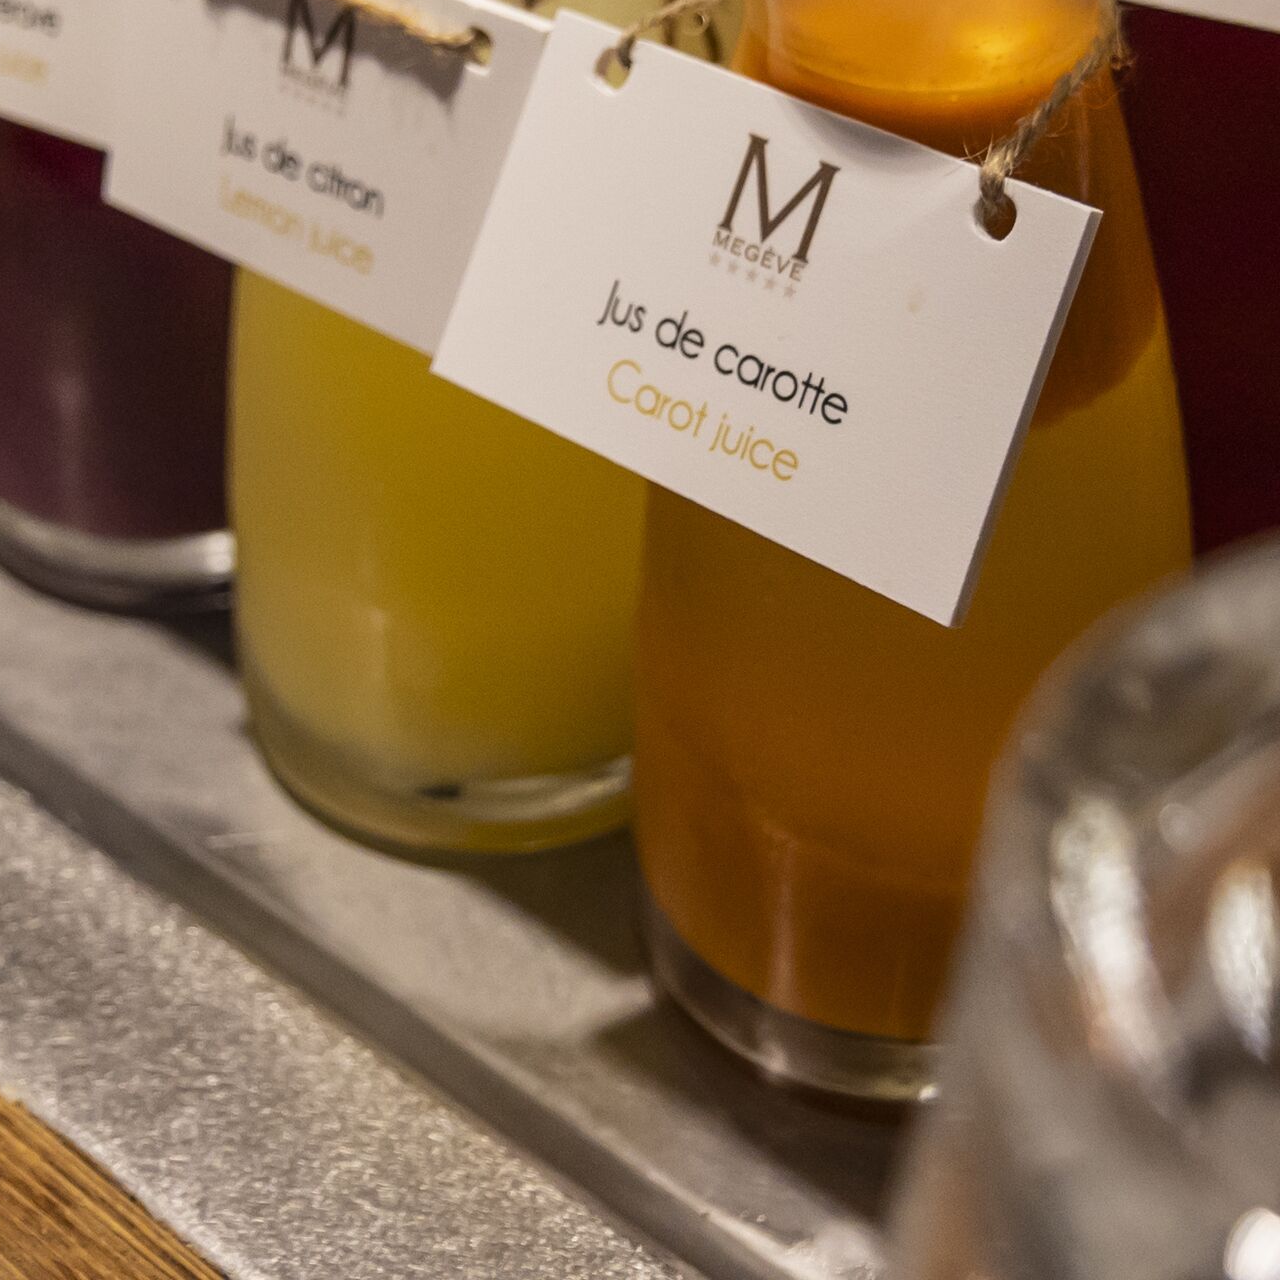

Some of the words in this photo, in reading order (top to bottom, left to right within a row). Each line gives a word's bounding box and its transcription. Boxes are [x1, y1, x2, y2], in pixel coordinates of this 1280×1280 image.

[261, 138, 303, 182] de
[305, 160, 385, 221] citron
[718, 133, 842, 264] M
[712, 230, 807, 282] MEGÈVE
[597, 280, 647, 333] Jus
[655, 310, 705, 359] de
[714, 344, 849, 425] carotte
[607, 359, 708, 438] Carot
[709, 412, 800, 482] juice
